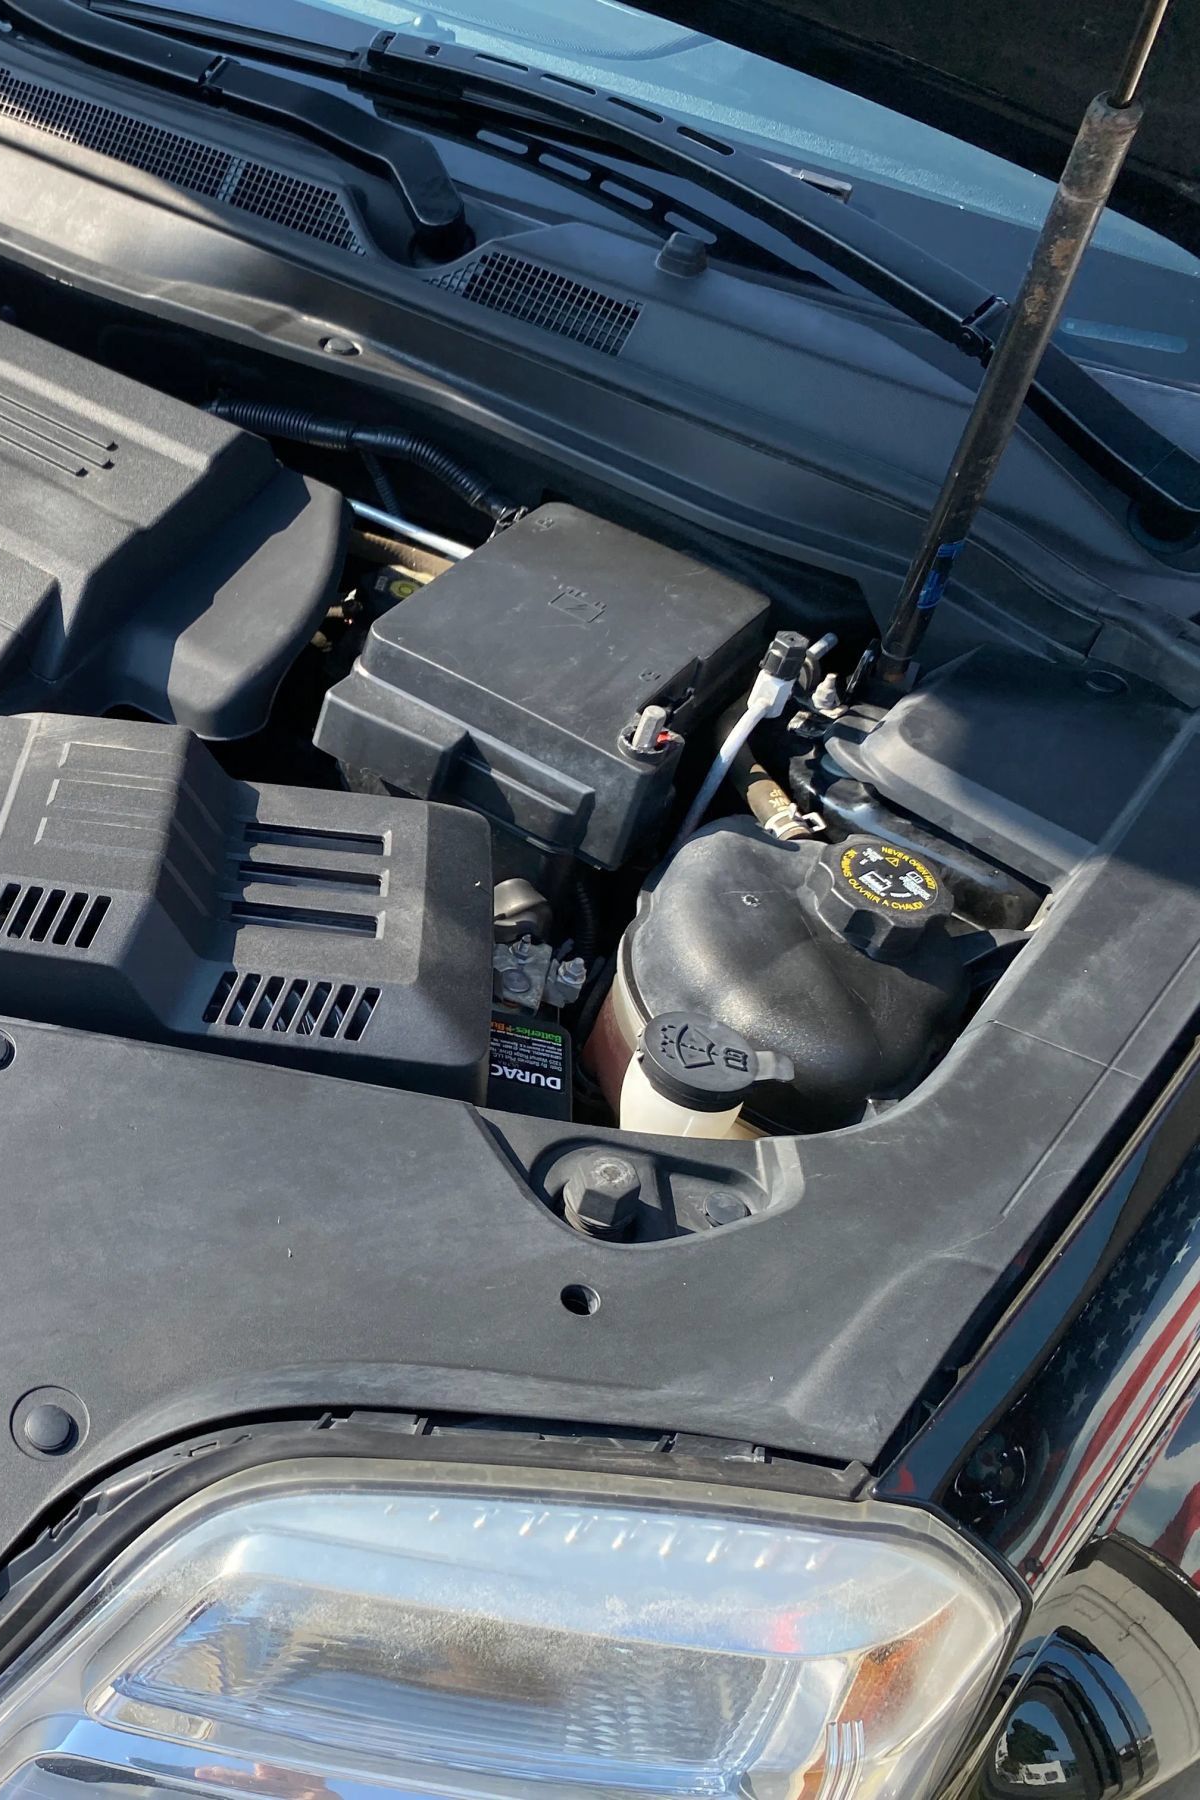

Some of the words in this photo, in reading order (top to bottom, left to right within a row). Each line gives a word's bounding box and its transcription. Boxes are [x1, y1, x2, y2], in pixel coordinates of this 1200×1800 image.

[881, 846, 910, 862] NEVER
[848, 878, 881, 903] OUVRIR
[490, 1063, 561, 1091] DURAC
